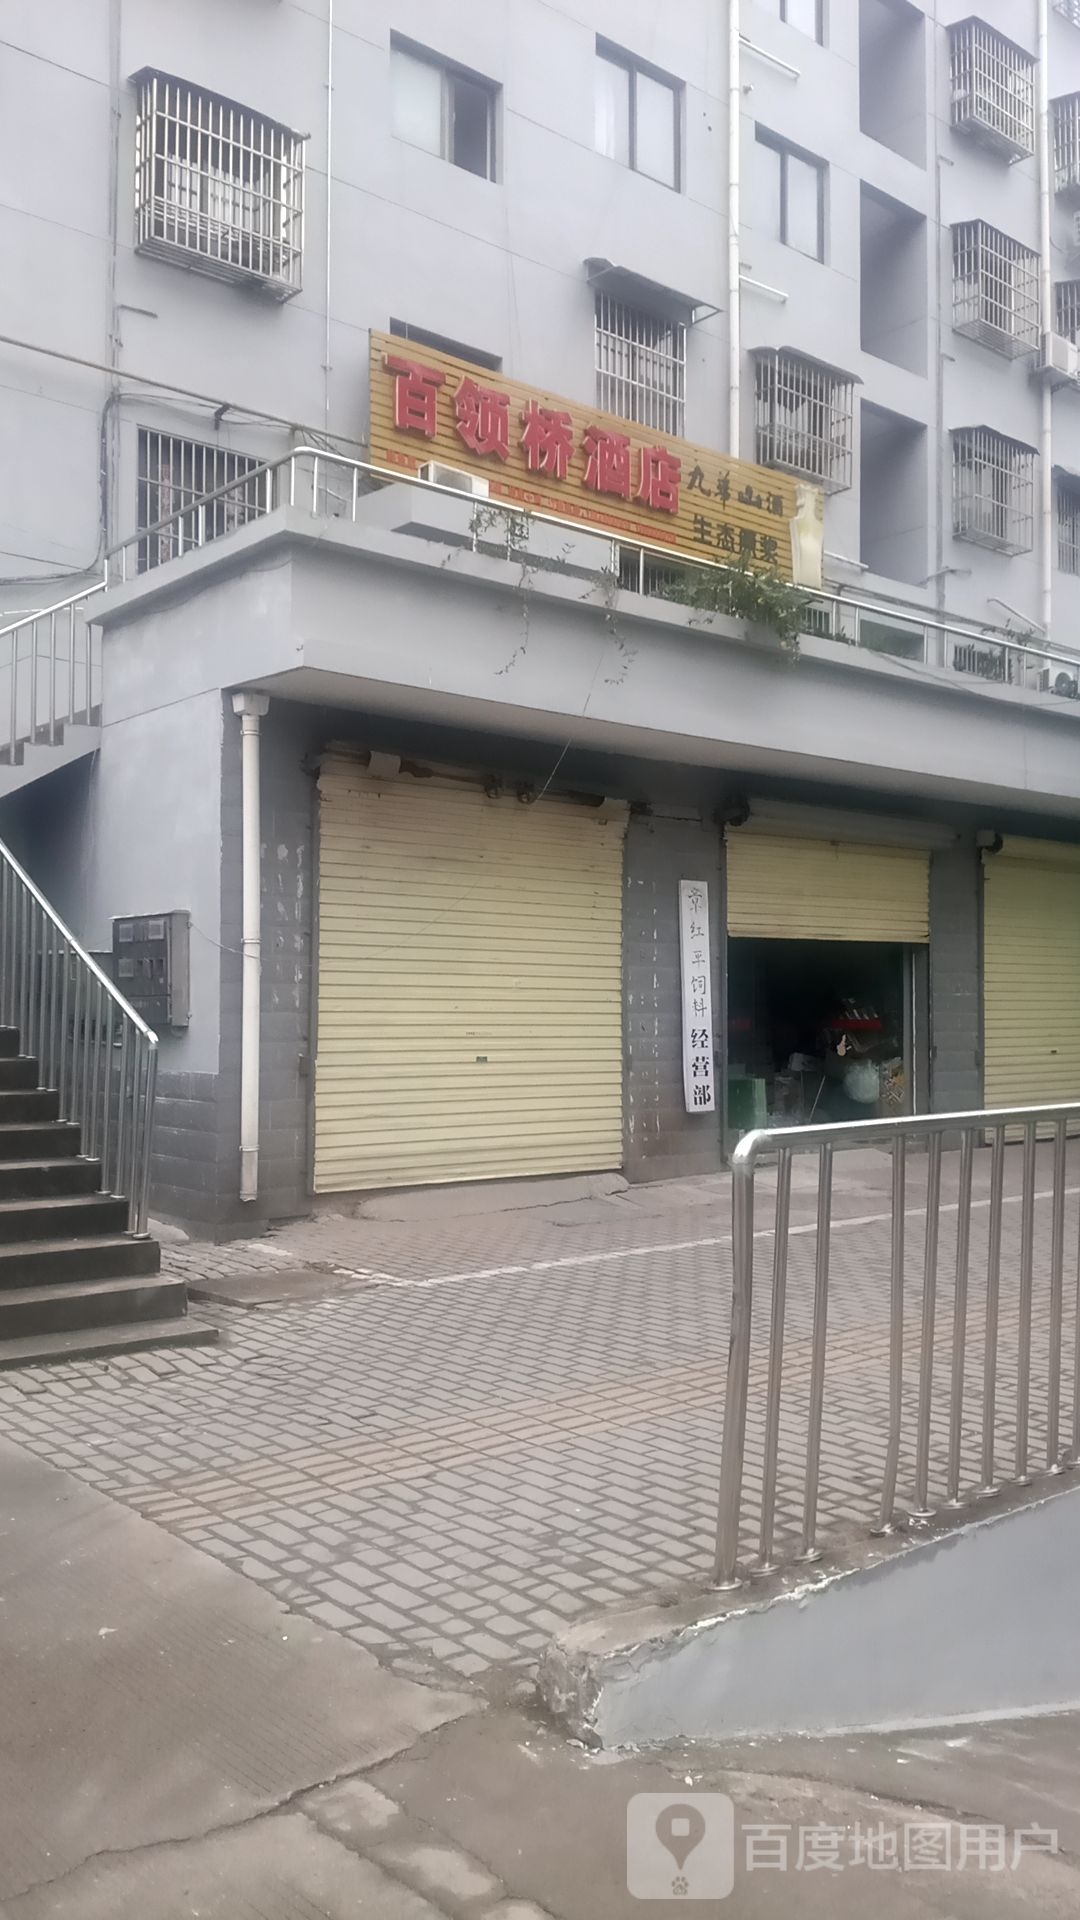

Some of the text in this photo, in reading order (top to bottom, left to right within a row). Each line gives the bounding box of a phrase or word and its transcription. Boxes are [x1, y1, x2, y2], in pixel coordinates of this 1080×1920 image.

[383, 353, 682, 514] 百领桥酒店
